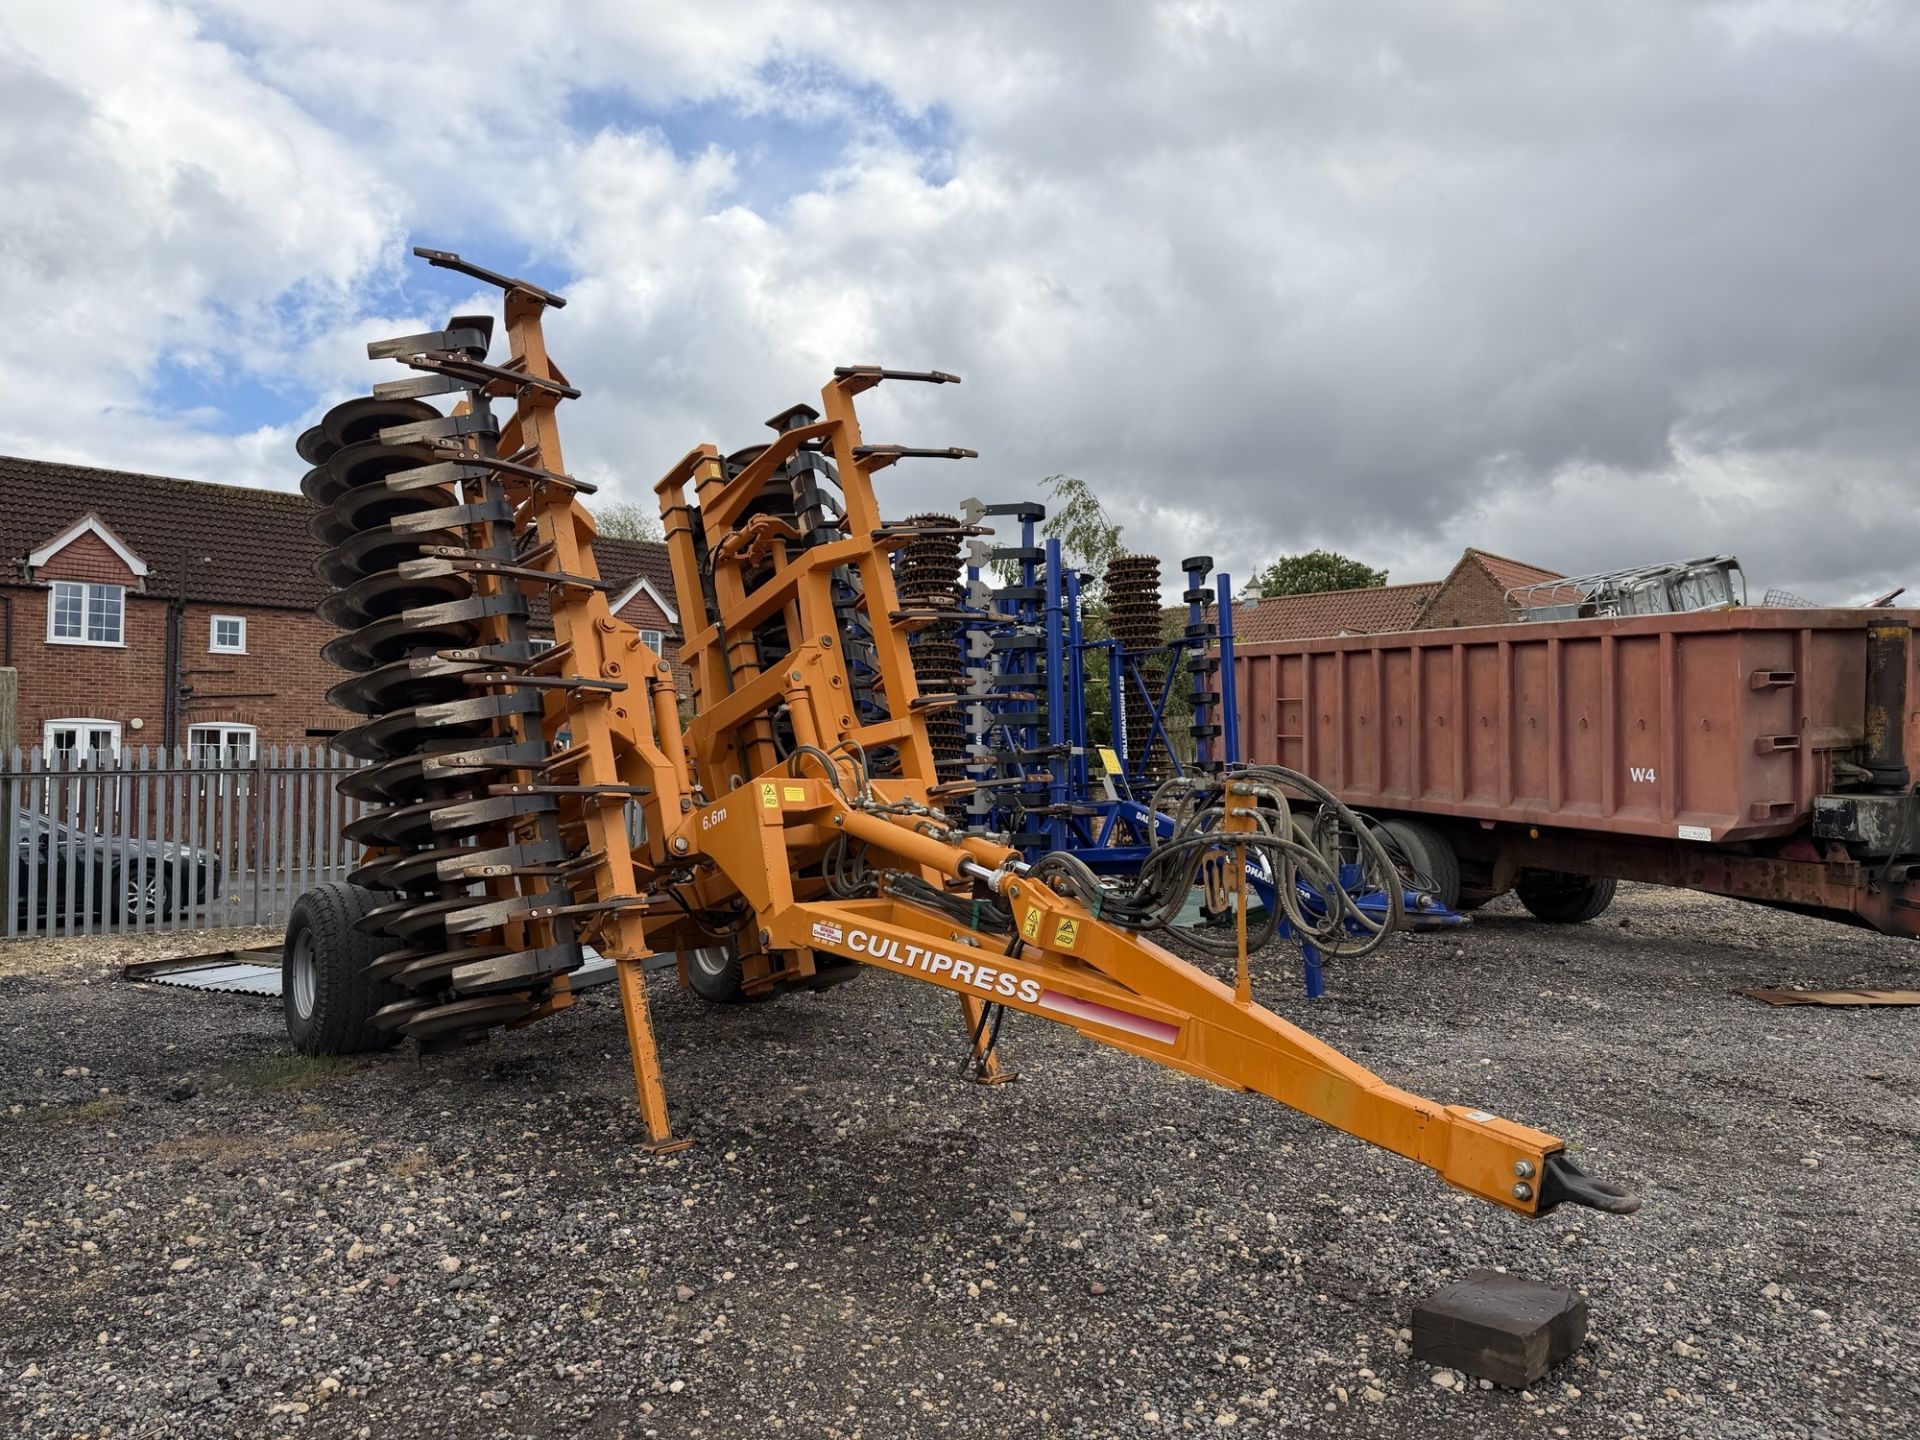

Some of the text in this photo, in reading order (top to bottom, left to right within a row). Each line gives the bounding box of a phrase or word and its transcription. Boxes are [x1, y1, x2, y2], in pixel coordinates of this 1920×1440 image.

[1119, 693, 1129, 760] ROLLOMAXIMUM
[1629, 767, 1656, 784] W4
[702, 808, 727, 830] 6.6m
[1135, 811, 1160, 828] DALO
[847, 929, 1041, 1004] CULTIPRESS
